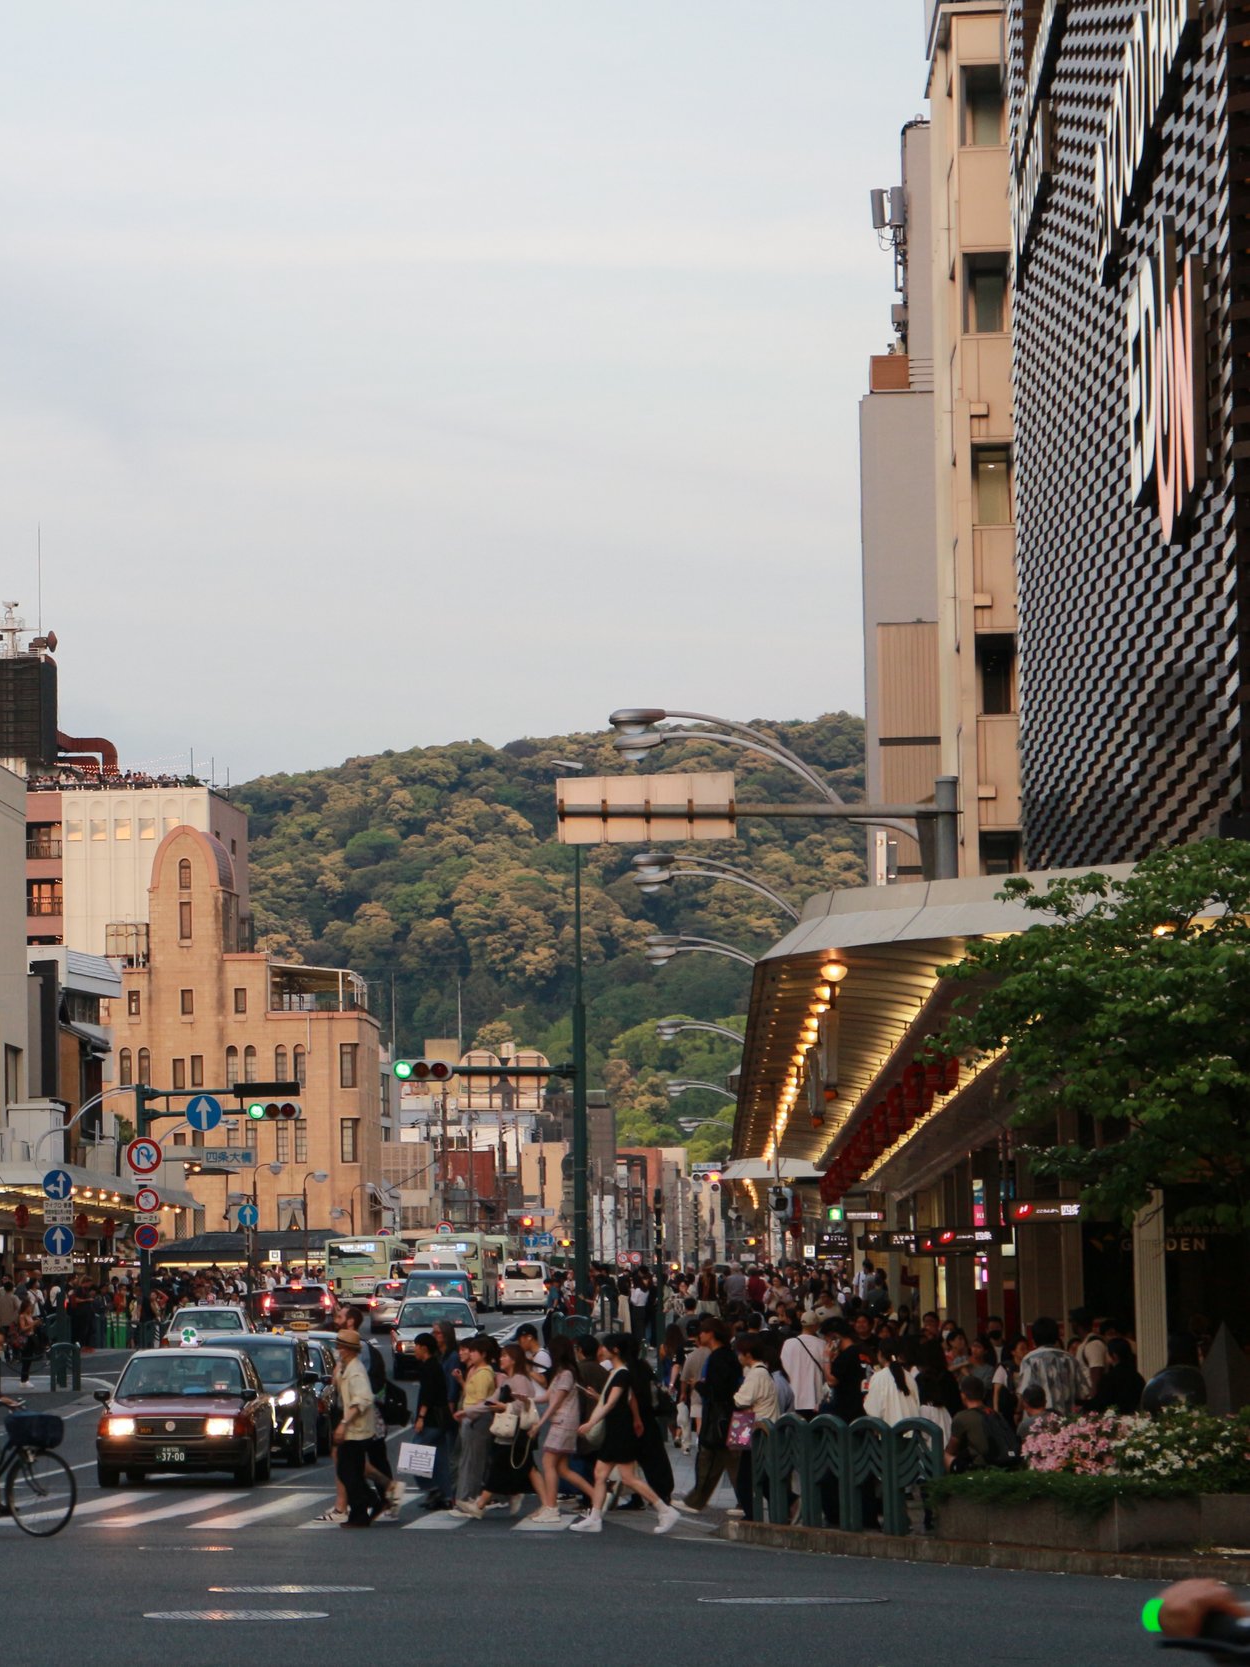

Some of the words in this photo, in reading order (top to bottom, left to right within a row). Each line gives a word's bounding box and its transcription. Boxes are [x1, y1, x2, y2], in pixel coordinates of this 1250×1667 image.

[1106, 10, 1146, 254] FOOD
[1148, 0, 1187, 128] HAL
[1127, 214, 1195, 547] EDION
